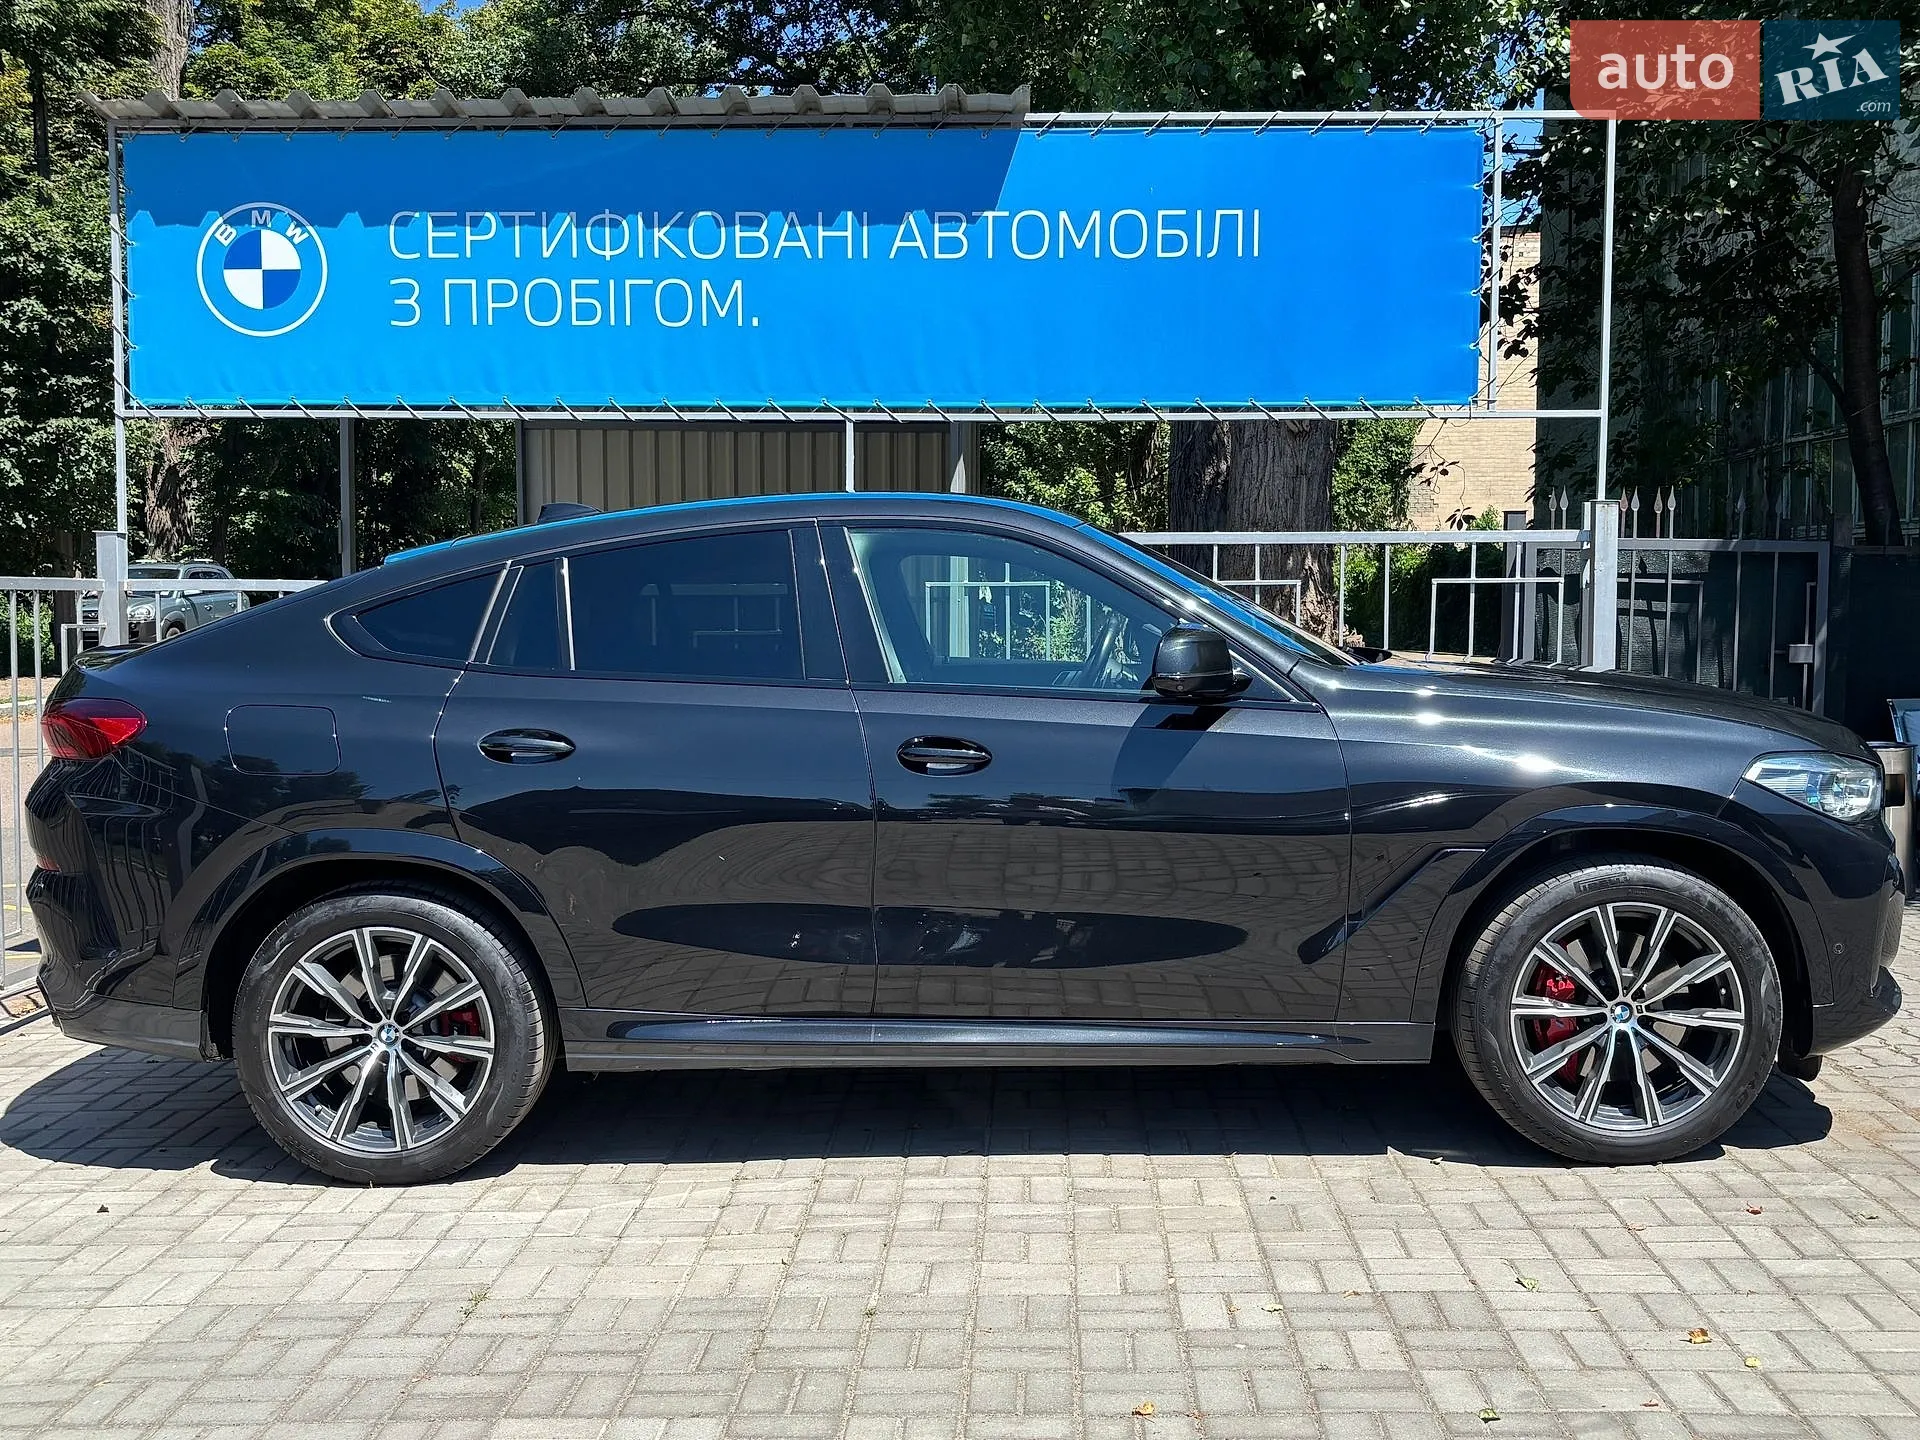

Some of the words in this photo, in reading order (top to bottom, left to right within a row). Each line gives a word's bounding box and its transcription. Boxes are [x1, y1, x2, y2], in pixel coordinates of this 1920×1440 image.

[387, 208, 870, 261] СЕРТИФІКОВАНІ
[888, 208, 1261, 260] АВТОМОБІЛІ
[443, 277, 761, 328] ПРОБІГОМ.
